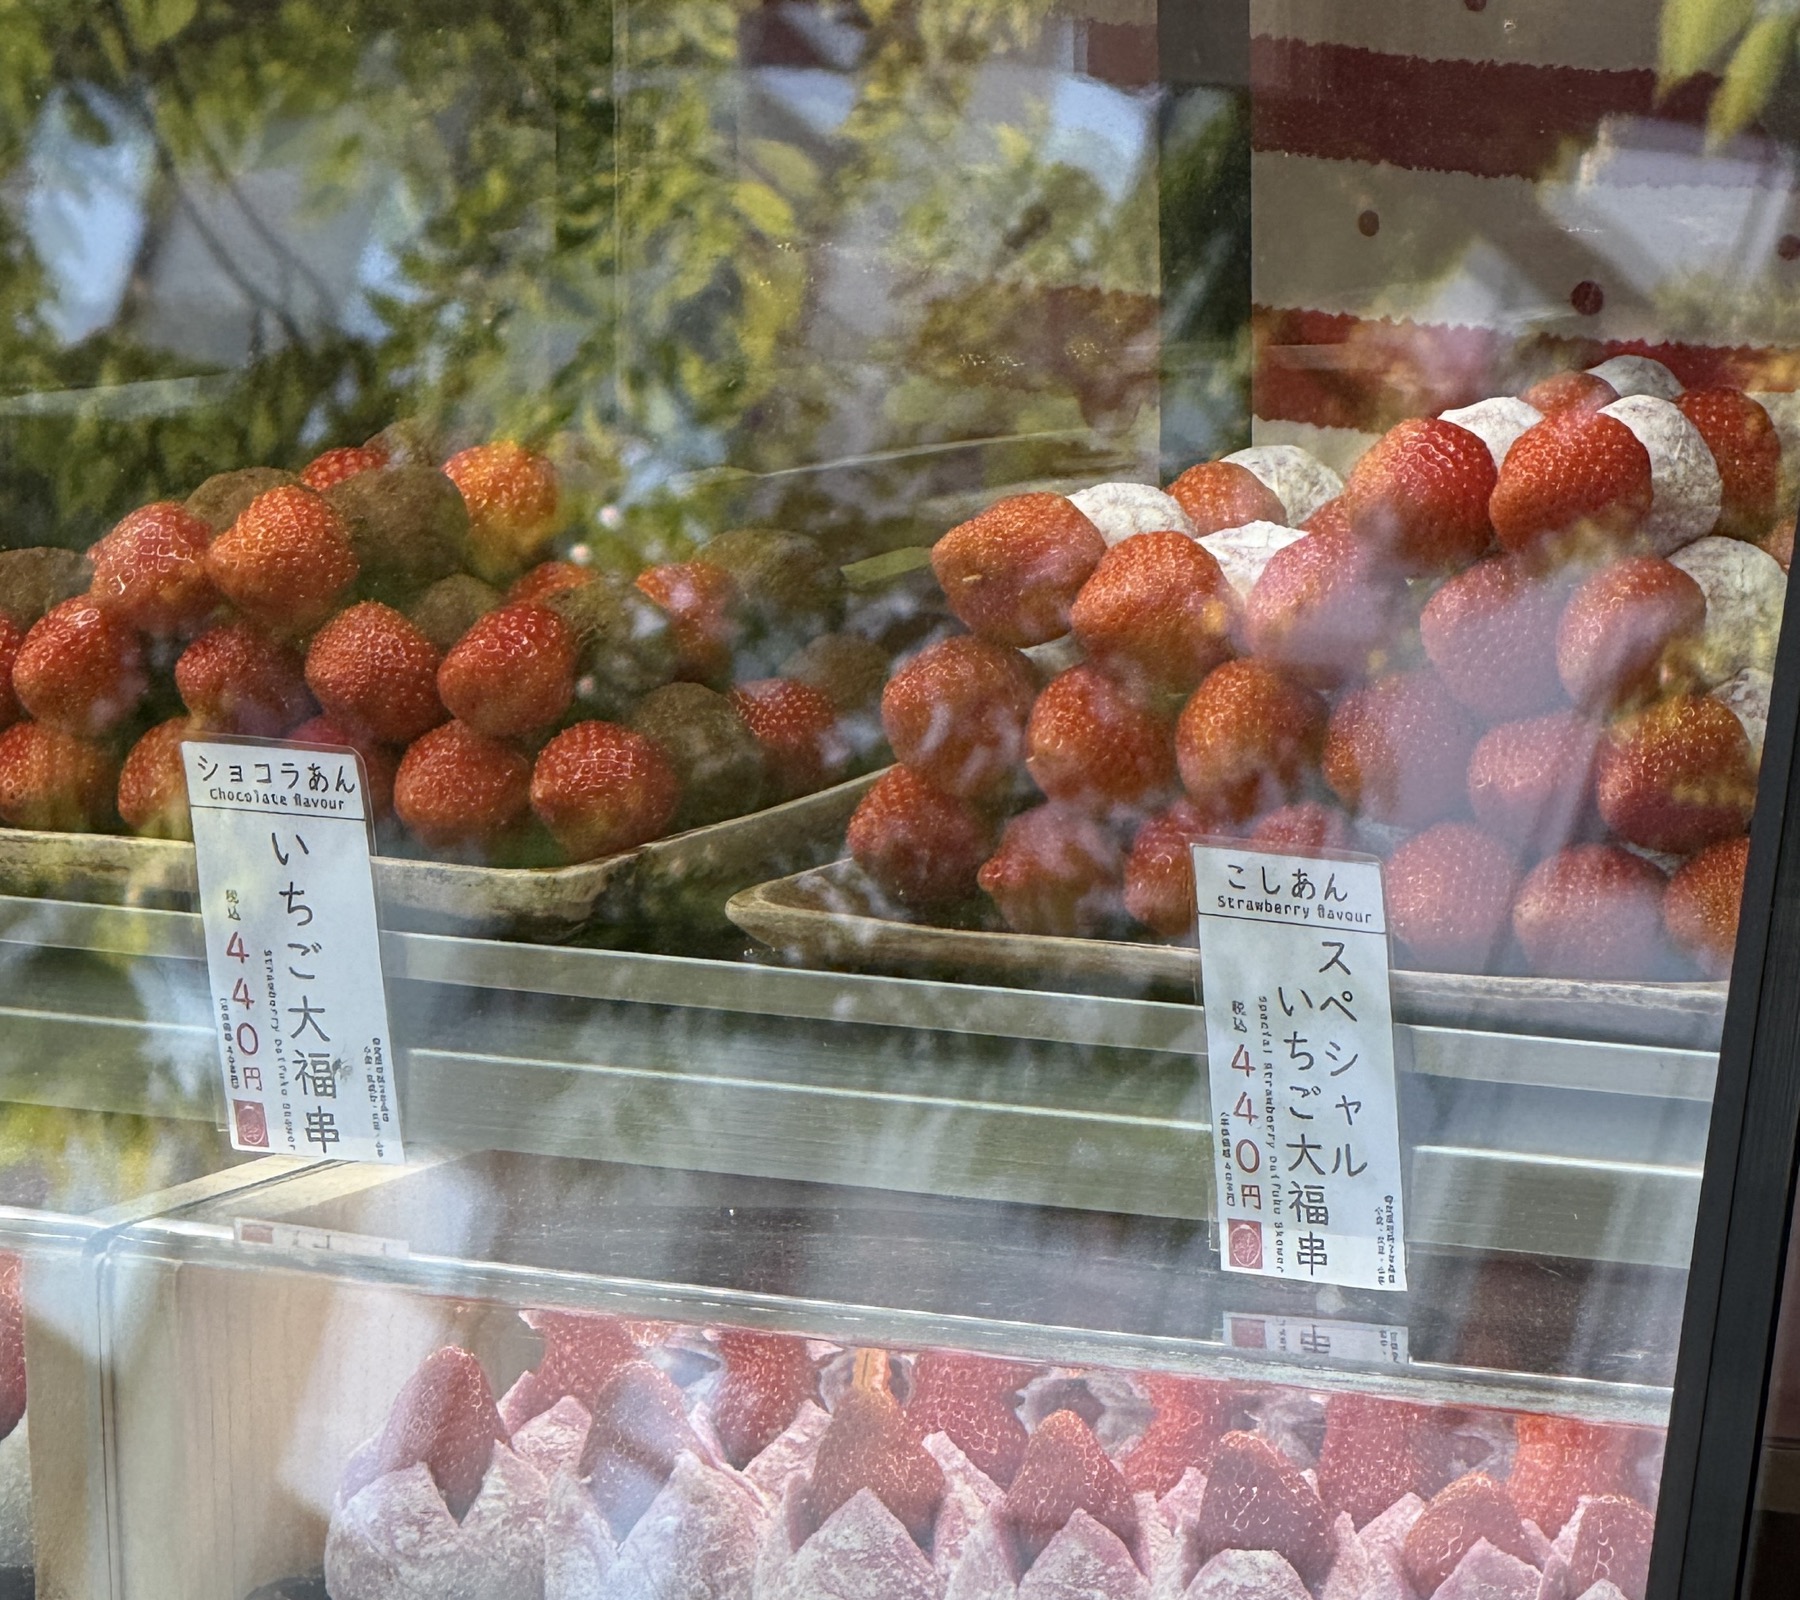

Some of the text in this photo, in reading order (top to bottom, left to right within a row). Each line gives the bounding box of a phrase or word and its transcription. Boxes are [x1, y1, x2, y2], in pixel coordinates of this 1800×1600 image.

[198, 755, 355, 794] ショコラあん
[294, 793, 345, 810] flavour
[1228, 864, 1348, 903] こしあん
[1317, 904, 1372, 923] flavour
[226, 931, 263, 1092] 440円
[271, 832, 341, 1153] いちご大福串
[1318, 941, 1368, 1178] スペシャル
[1231, 1044, 1262, 1210] 440円
[1277, 986, 1330, 1276] いちご大福串
